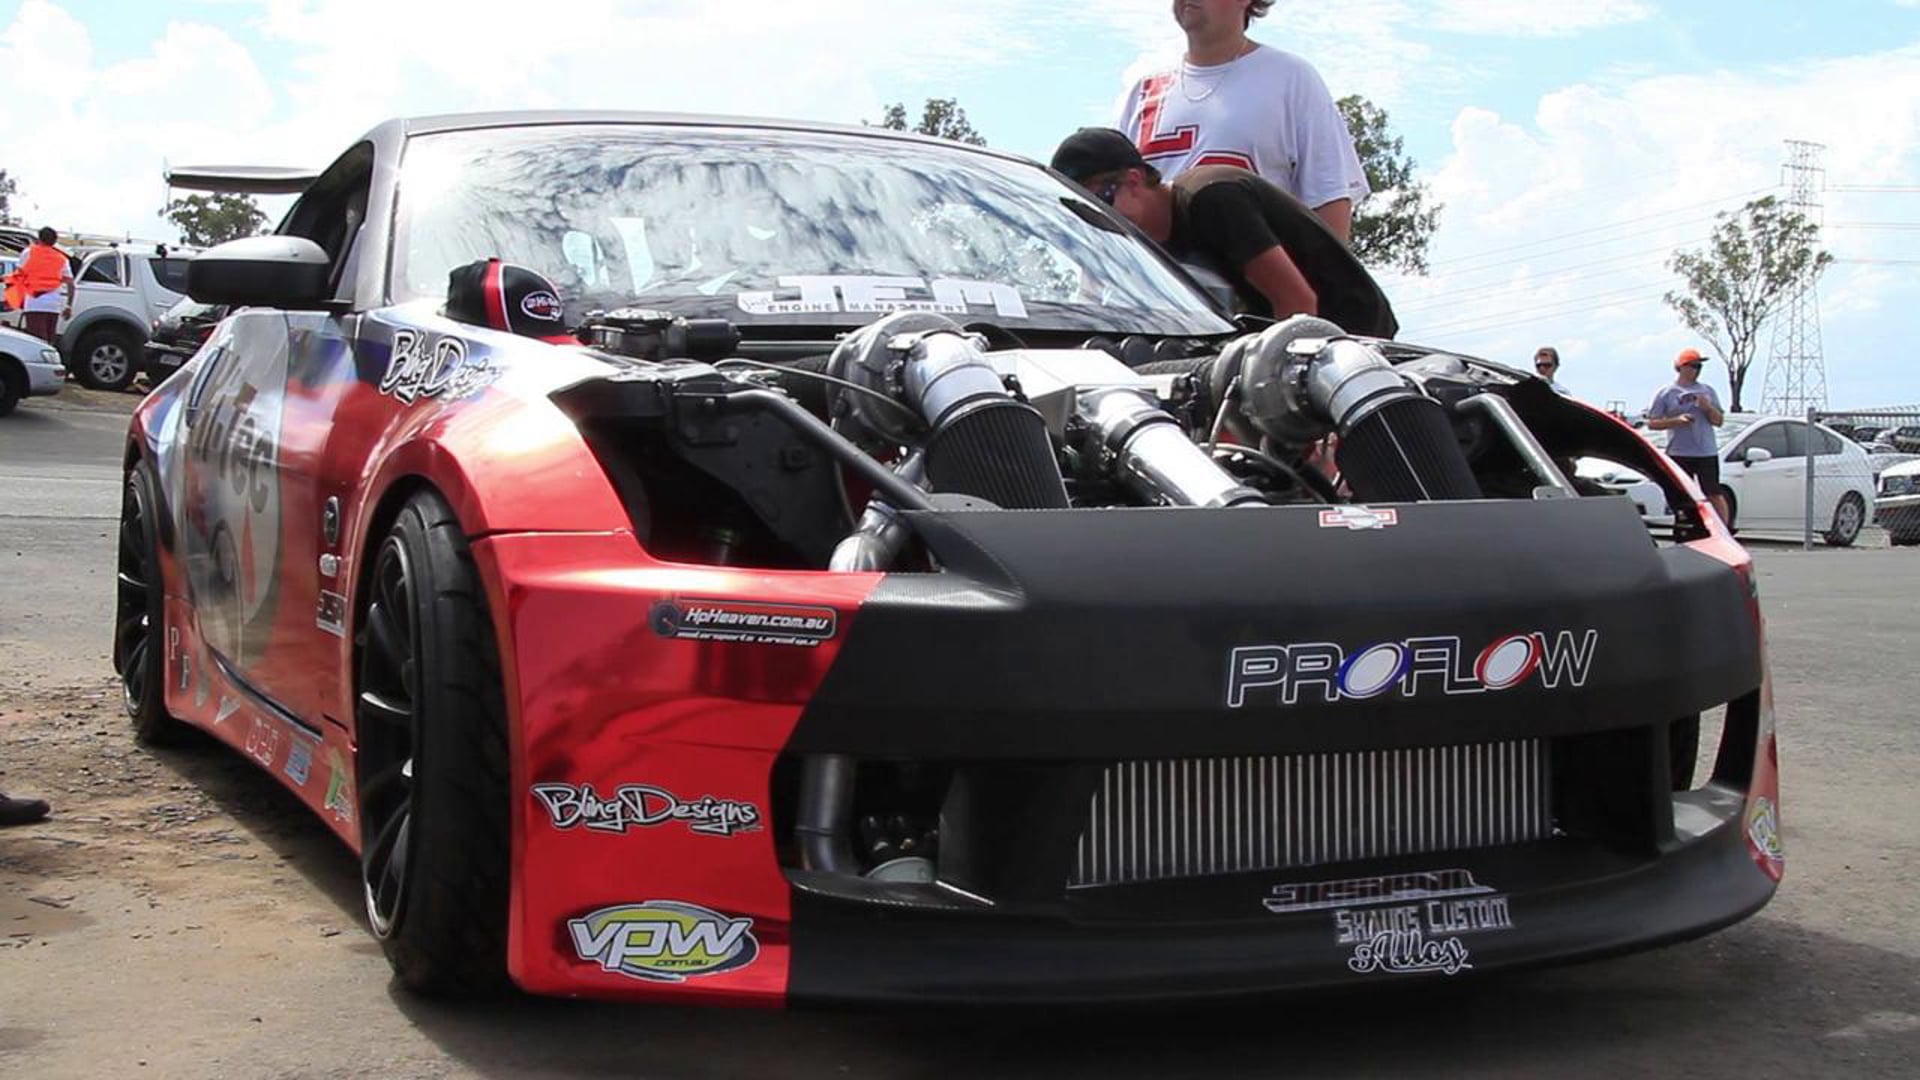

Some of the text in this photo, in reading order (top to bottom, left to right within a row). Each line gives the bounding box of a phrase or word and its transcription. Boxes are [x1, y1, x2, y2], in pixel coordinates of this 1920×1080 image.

[767, 303, 833, 313] ENGINE
[849, 302, 966, 313] MANAGEMENT
[685, 607, 829, 631] HpHeaven.com.au
[1227, 629, 1598, 708] PROFLOW
[531, 784, 757, 836] Bling Designs
[1348, 929, 1473, 975] Alloy
